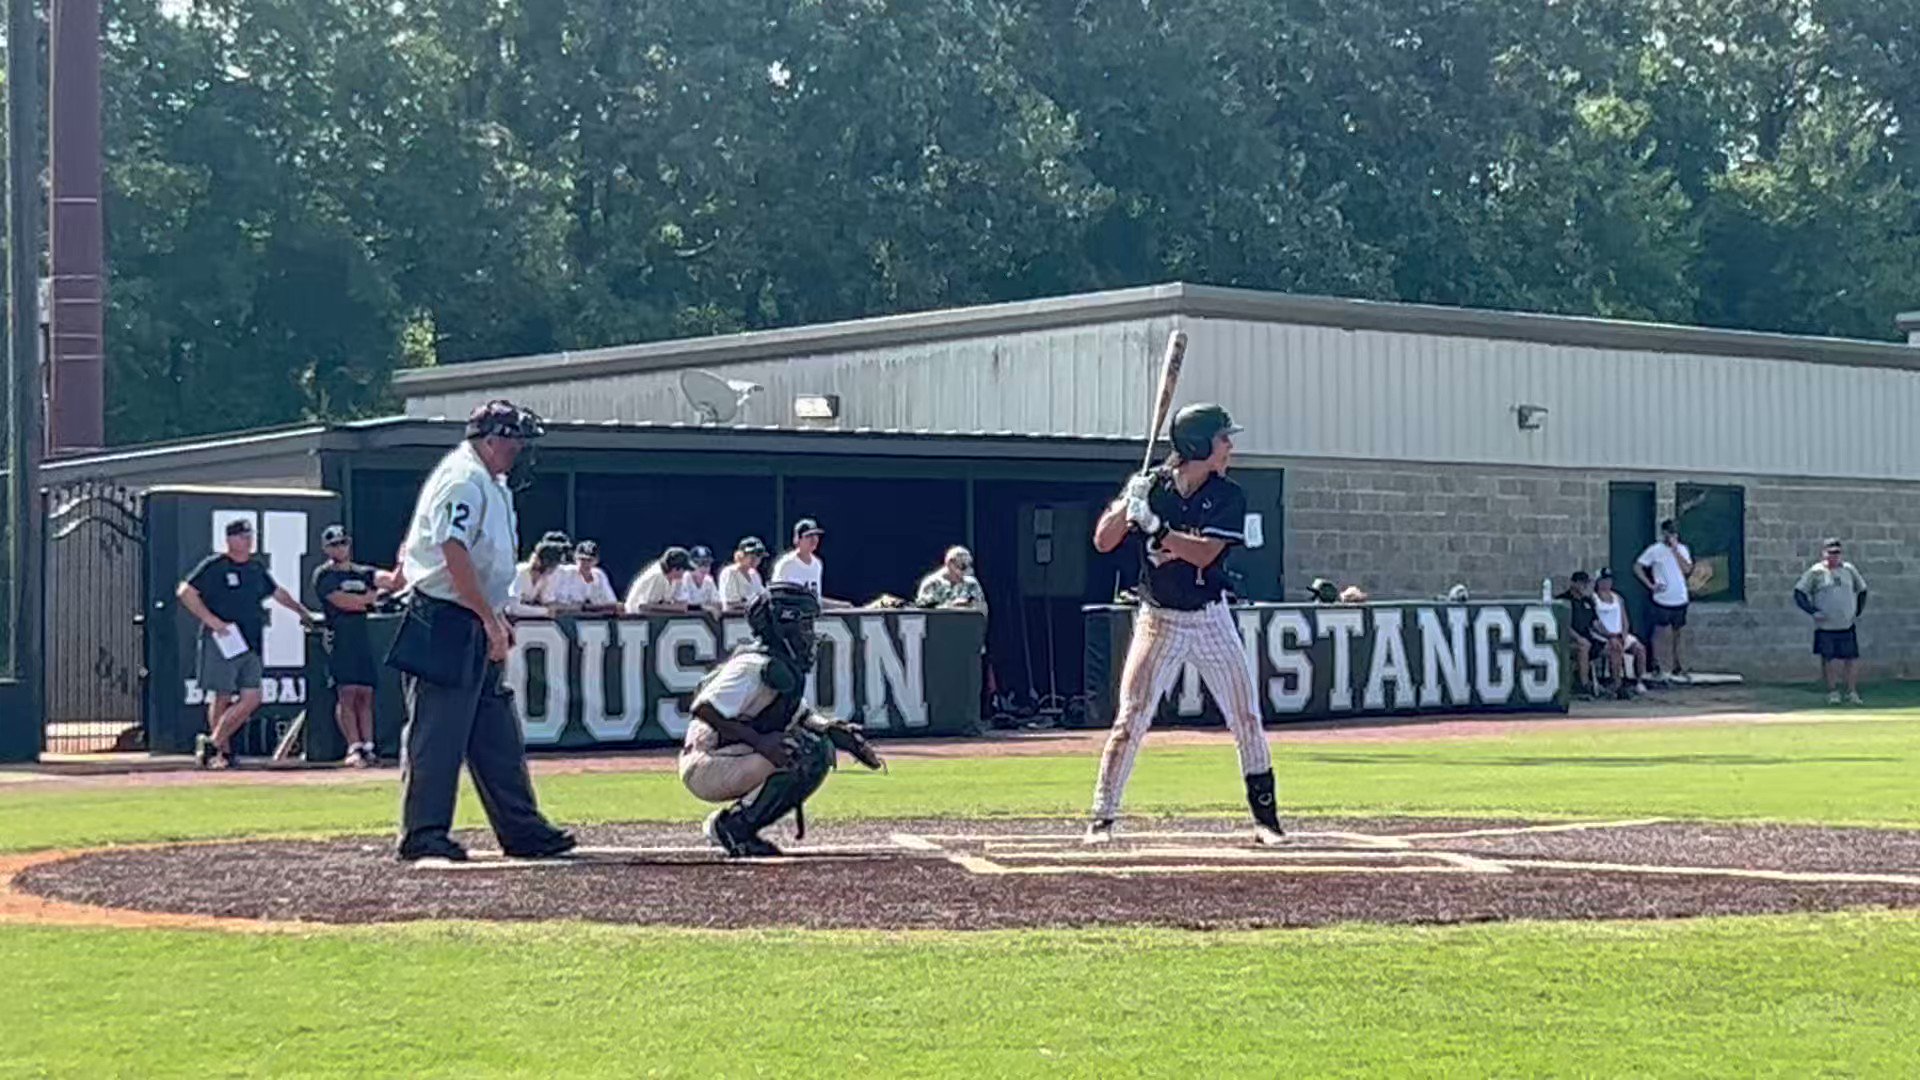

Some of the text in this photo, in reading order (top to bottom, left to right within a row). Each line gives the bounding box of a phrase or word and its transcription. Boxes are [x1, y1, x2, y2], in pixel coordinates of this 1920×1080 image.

[446, 502, 470, 532] 12
[505, 614, 929, 744] OUSON
[1133, 606, 1560, 717] STANGS
